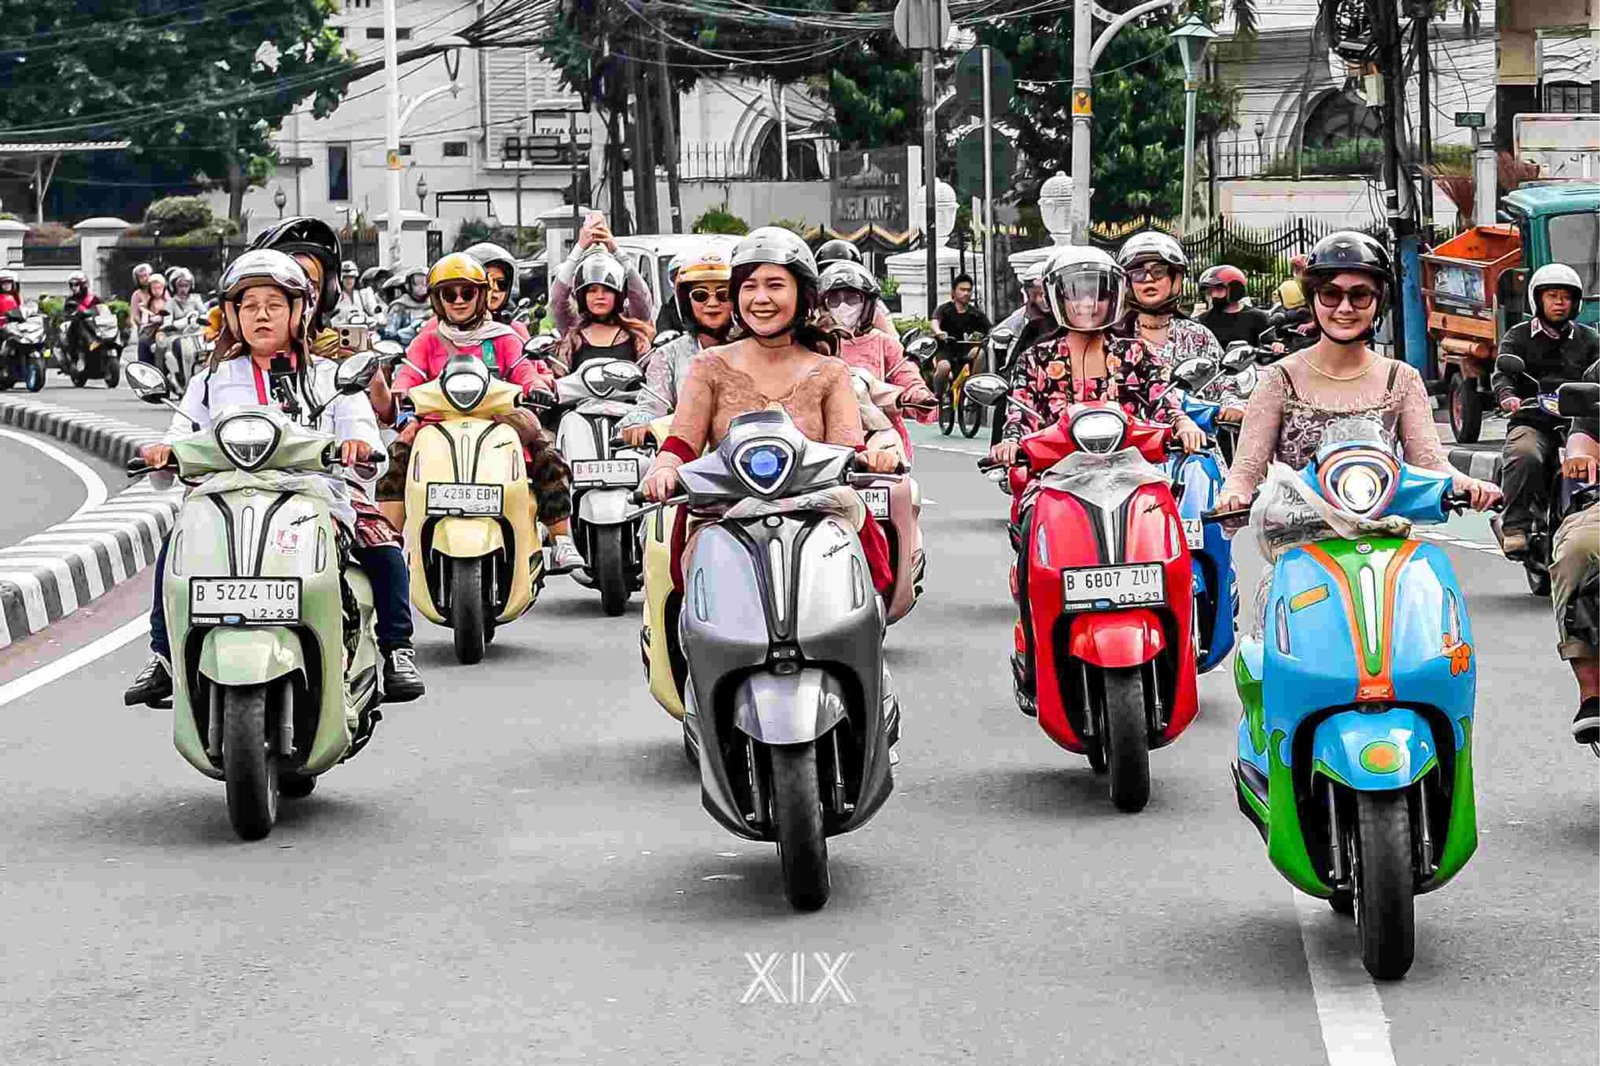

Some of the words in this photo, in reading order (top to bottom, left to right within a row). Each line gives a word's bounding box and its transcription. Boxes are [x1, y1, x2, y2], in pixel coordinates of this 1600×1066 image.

[430, 487, 437, 499] B
[1066, 574, 1075, 590] B
[1085, 571, 1121, 589] 6807
[1131, 569, 1158, 586] ZUY
[196, 585, 205, 601] B
[216, 584, 258, 600] 5224
[266, 584, 295, 600] TUG
